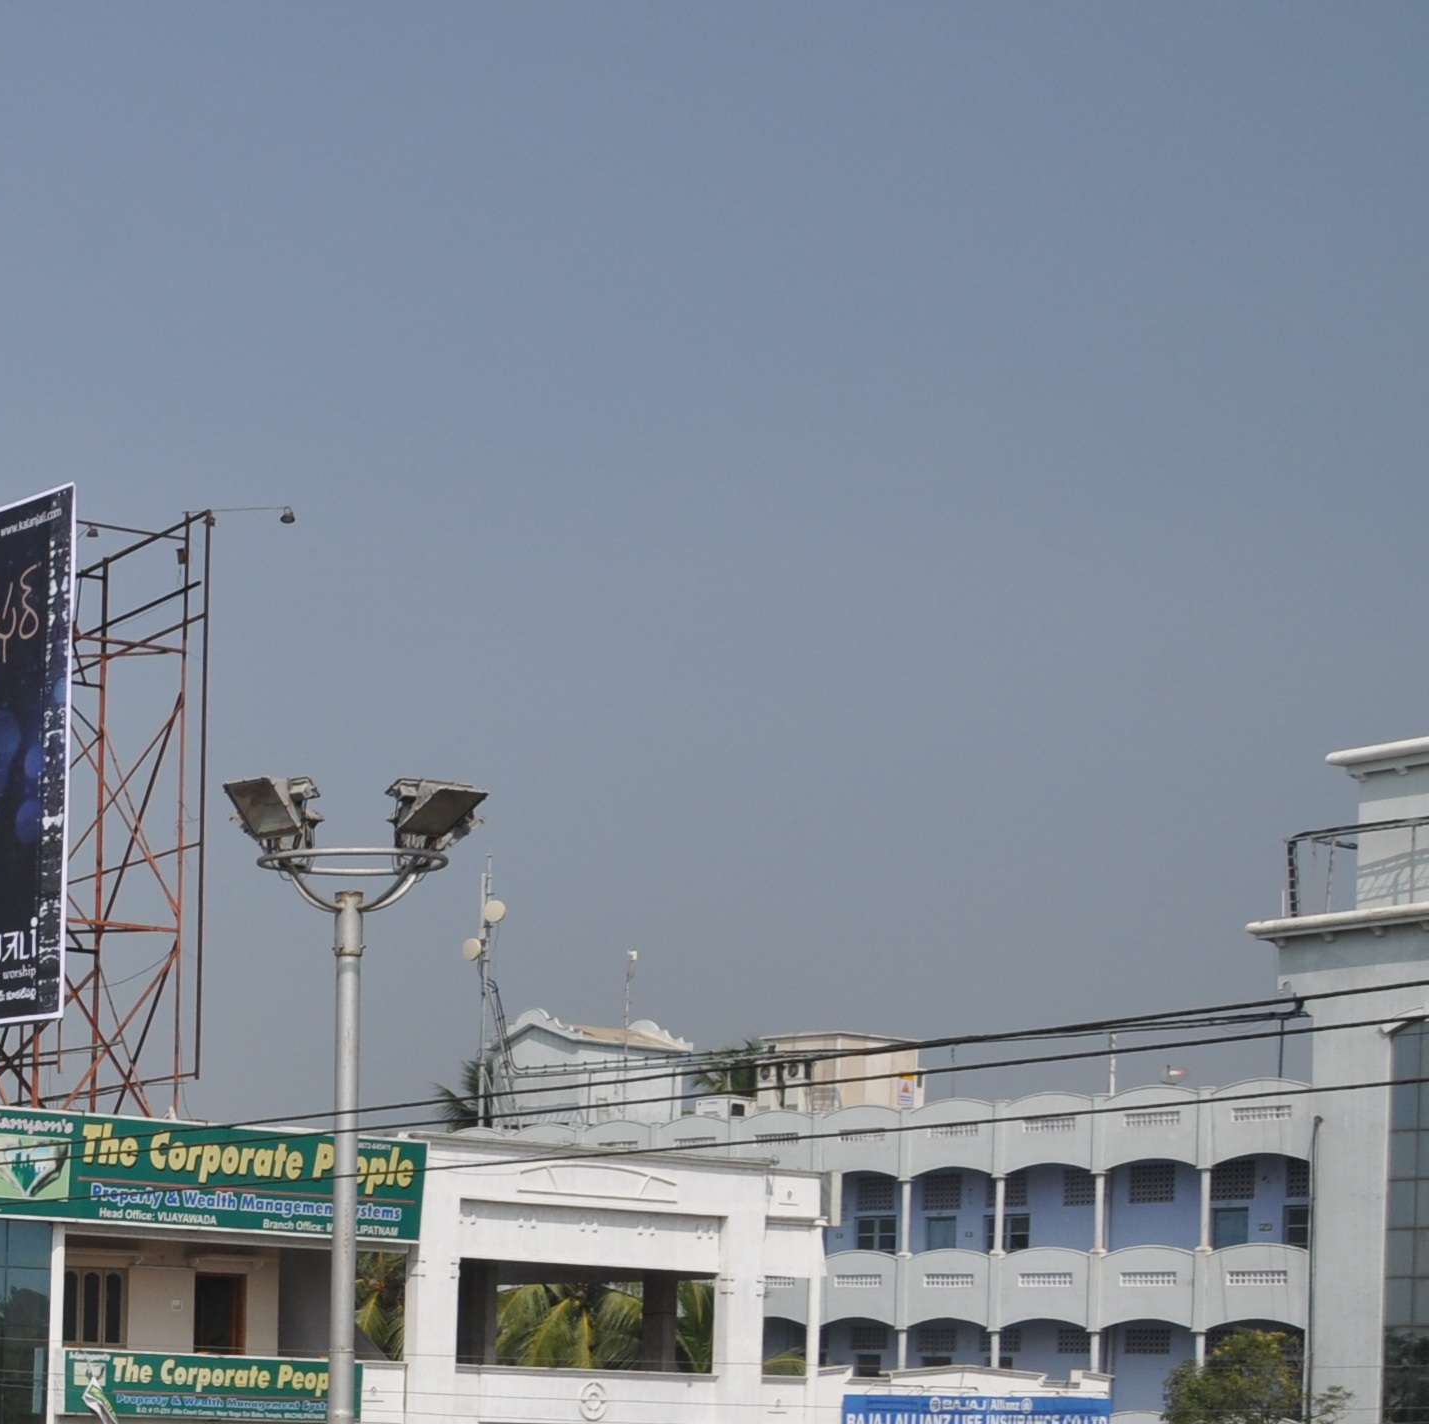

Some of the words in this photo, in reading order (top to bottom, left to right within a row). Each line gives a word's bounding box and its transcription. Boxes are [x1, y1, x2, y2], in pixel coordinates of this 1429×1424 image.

[3, 964, 37, 979] worship
[82, 1123, 138, 1168] The
[149, 1131, 304, 1183] Corporate
[313, 1143, 414, 1194] Pople
[91, 1183, 165, 1207] Property
[167, 1189, 180, 1206] &
[182, 1189, 238, 1211] Wealth
[241, 1194, 333, 1217] Managemen
[355, 1202, 402, 1222] ystems
[99, 1207, 122, 1220] Head
[124, 1209, 155, 1222] Office:
[157, 1211, 217, 1226] VIJAYAWADA
[263, 1219, 289, 1231] Branch
[291, 1220, 324, 1234] Office:
[113, 1357, 153, 1384] The
[160, 1359, 271, 1393] Corporate
[278, 1365, 329, 1397] Peop
[116, 1393, 169, 1407] Property
[171, 1395, 181, 1405] &
[184, 1395, 223, 1408] Wealth
[226, 1398, 300, 1411] Management
[942, 1399, 986, 1410] BAJAJ
[990, 1399, 1020, 1410] Allianz
